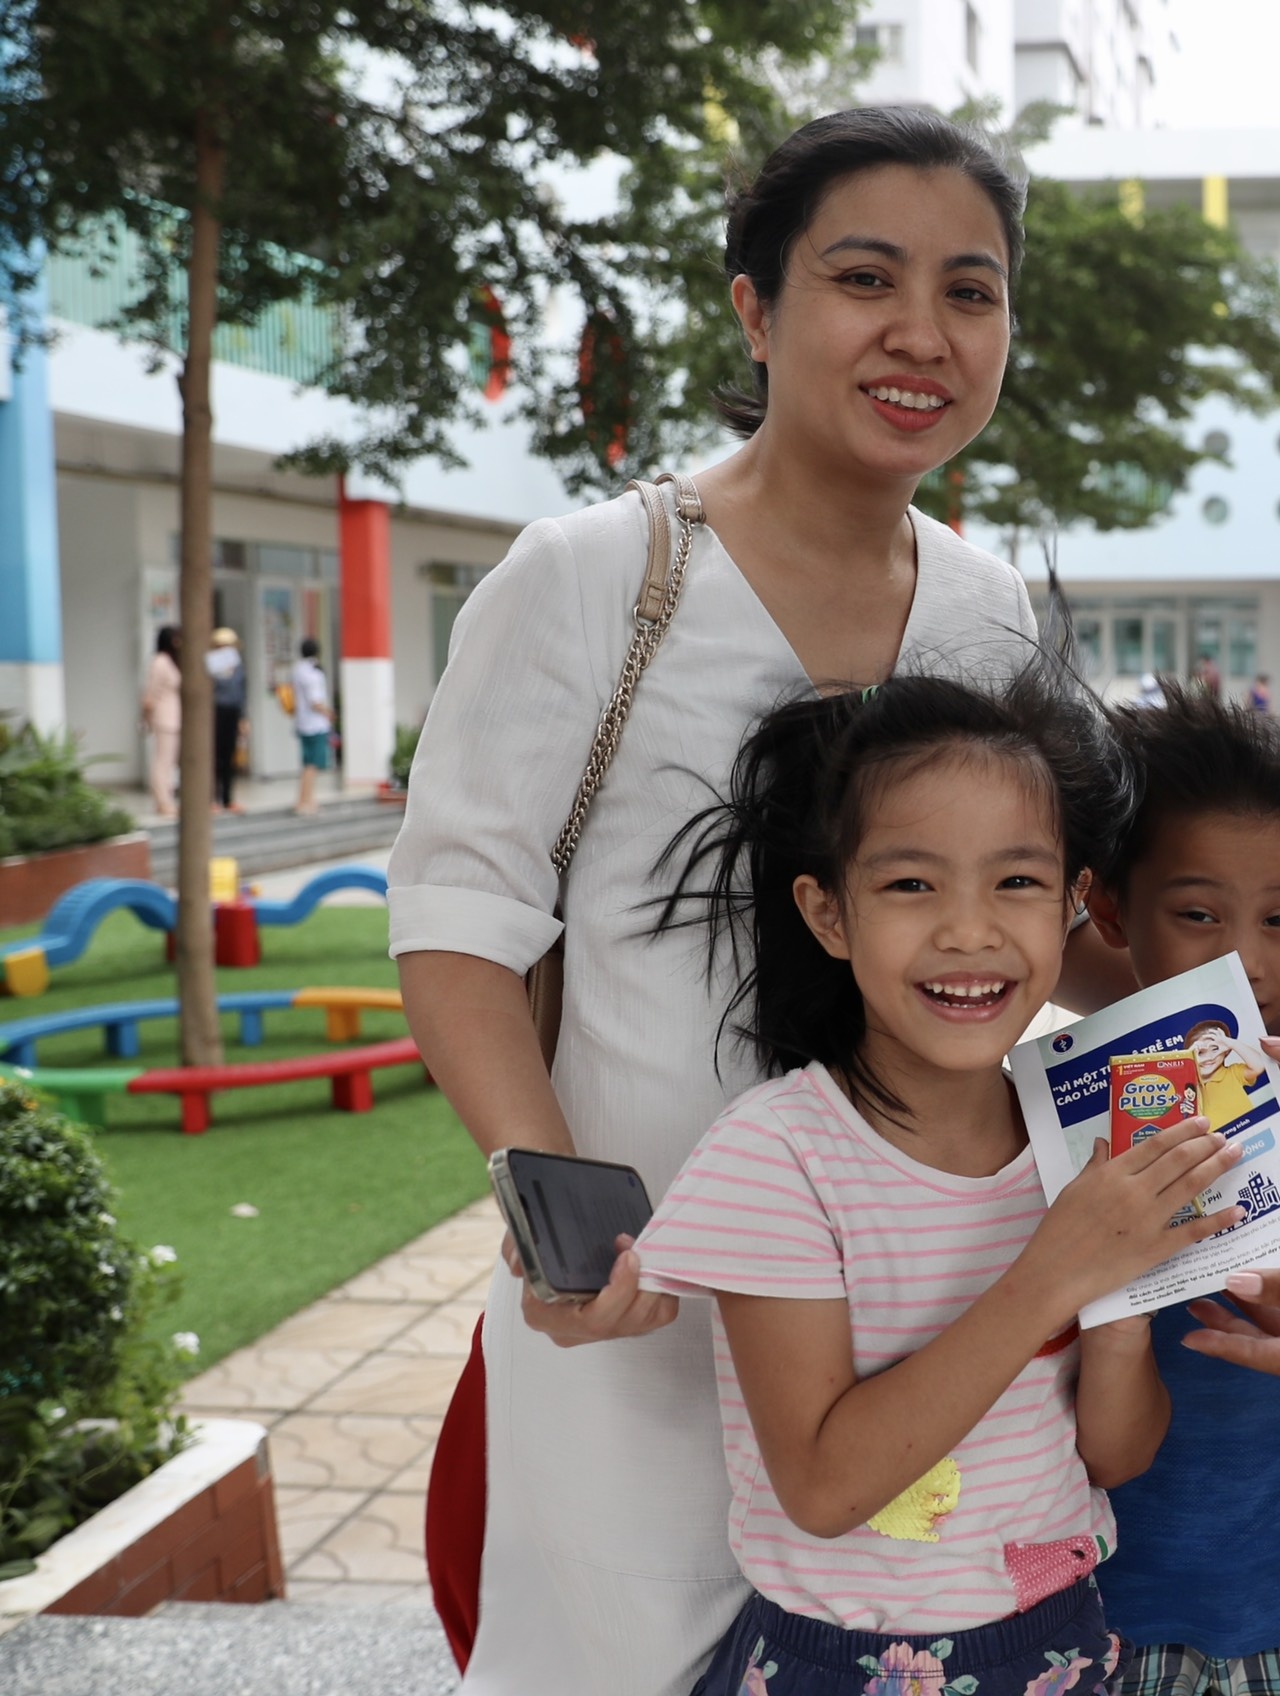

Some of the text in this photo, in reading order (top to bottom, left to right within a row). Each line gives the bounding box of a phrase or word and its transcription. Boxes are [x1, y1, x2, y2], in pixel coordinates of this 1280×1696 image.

[1073, 1070, 1098, 1088] MỘT
[1140, 1039, 1164, 1054] TRẺ
[1165, 1035, 1184, 1047] EM
[1056, 1079, 1108, 1106] CAO LỚN
[1124, 1082, 1170, 1094] Grow
[1120, 1094, 1178, 1109] PLUS+
[1207, 1191, 1222, 1204] PHÌ
